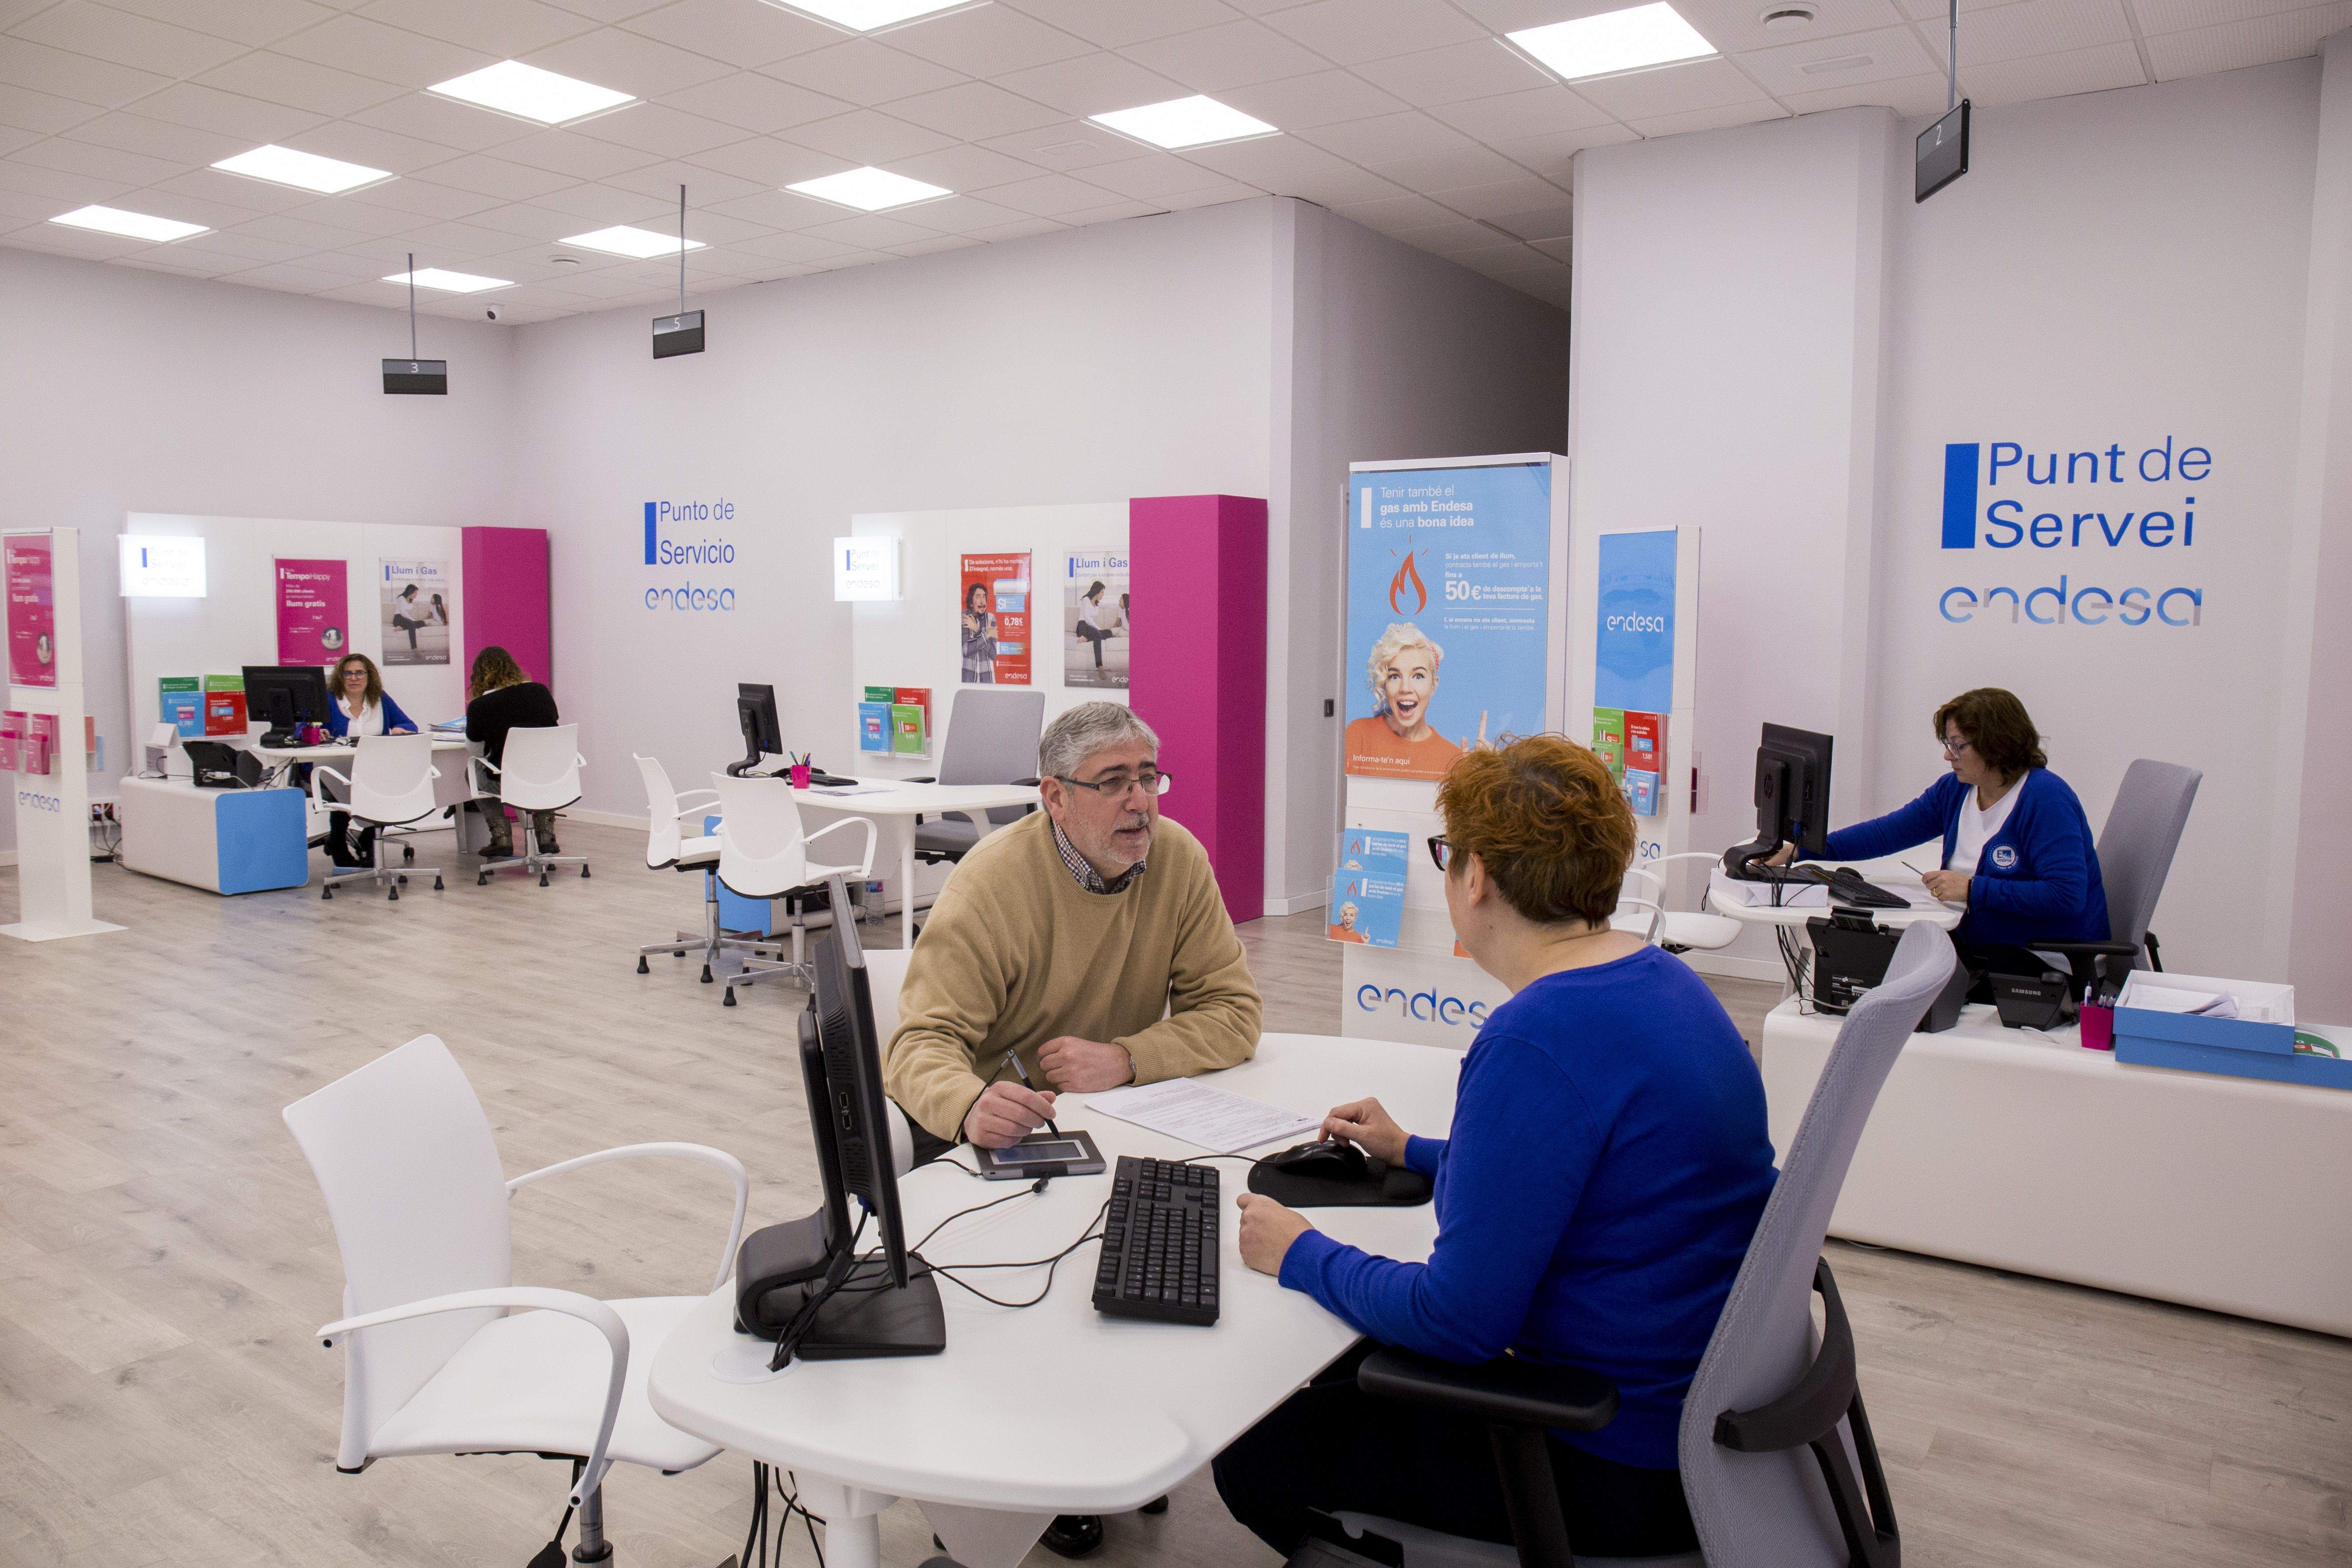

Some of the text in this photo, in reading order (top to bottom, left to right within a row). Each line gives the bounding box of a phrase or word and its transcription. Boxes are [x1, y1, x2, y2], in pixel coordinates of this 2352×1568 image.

[1936, 125, 1942, 146] 2
[674, 318, 681, 329] 5
[411, 363, 418, 373] 3
[1989, 435, 2212, 486] Punt de
[1381, 485, 1454, 498] Tenir també el
[661, 497, 734, 521] Punto de
[1380, 501, 1473, 516] gas amb Endesa
[1380, 519, 1392, 528] és
[1417, 517, 1446, 527] bona
[1450, 516, 1474, 526] idea
[1985, 497, 2195, 549] Servei
[660, 538, 735, 564] Servicio
[852, 560, 879, 571] Servei
[1076, 557, 1128, 568] Llum i Gas
[645, 581, 735, 611] endesa
[1939, 575, 2202, 626] endesa
[1607, 611, 1663, 632] endesa
[1353, 755, 1394, 763] Informa-te'n
[1357, 984, 1487, 1030] endes
